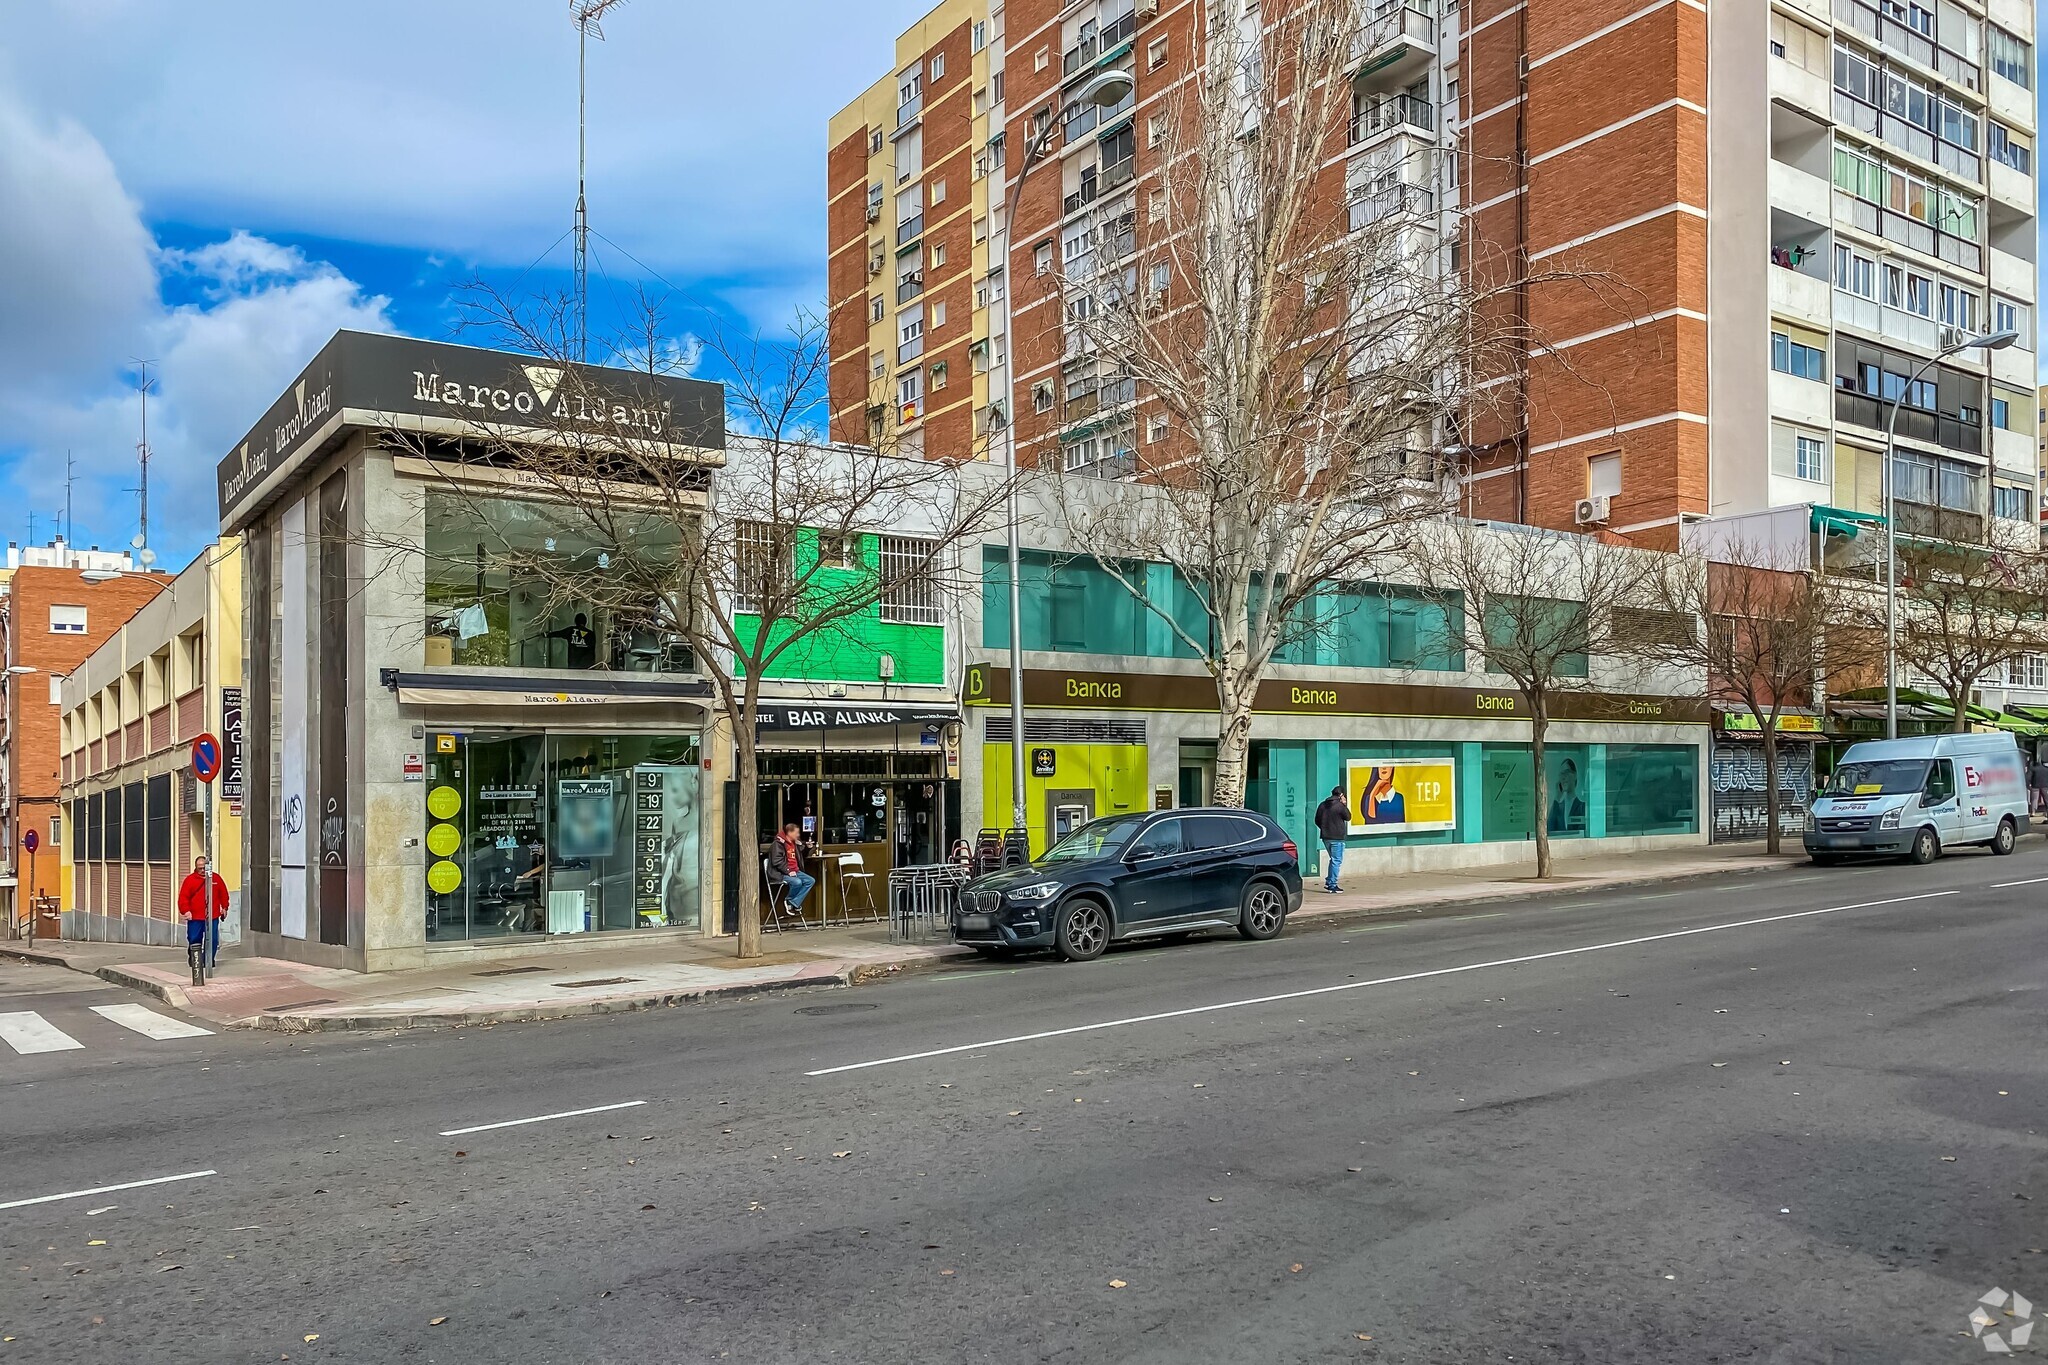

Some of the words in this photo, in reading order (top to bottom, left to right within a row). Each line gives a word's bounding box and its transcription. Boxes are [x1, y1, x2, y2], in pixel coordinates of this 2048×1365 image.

[412, 371, 534, 414] Marco
[552, 393, 668, 434] Aldany
[274, 413, 300, 454] Marco
[302, 384, 332, 429] Aldany
[224, 469, 245, 504] Marco
[245, 447, 268, 483] Aldany
[1066, 678, 1122, 698] Bankia
[1291, 687, 1337, 705] Bankia
[524, 695, 559, 703] Marco
[1476, 694, 1514, 710] Bankia
[787, 711, 827, 726] BAR
[835, 711, 901, 726] ALINKA
[1971, 806, 1988, 817] FedEx
